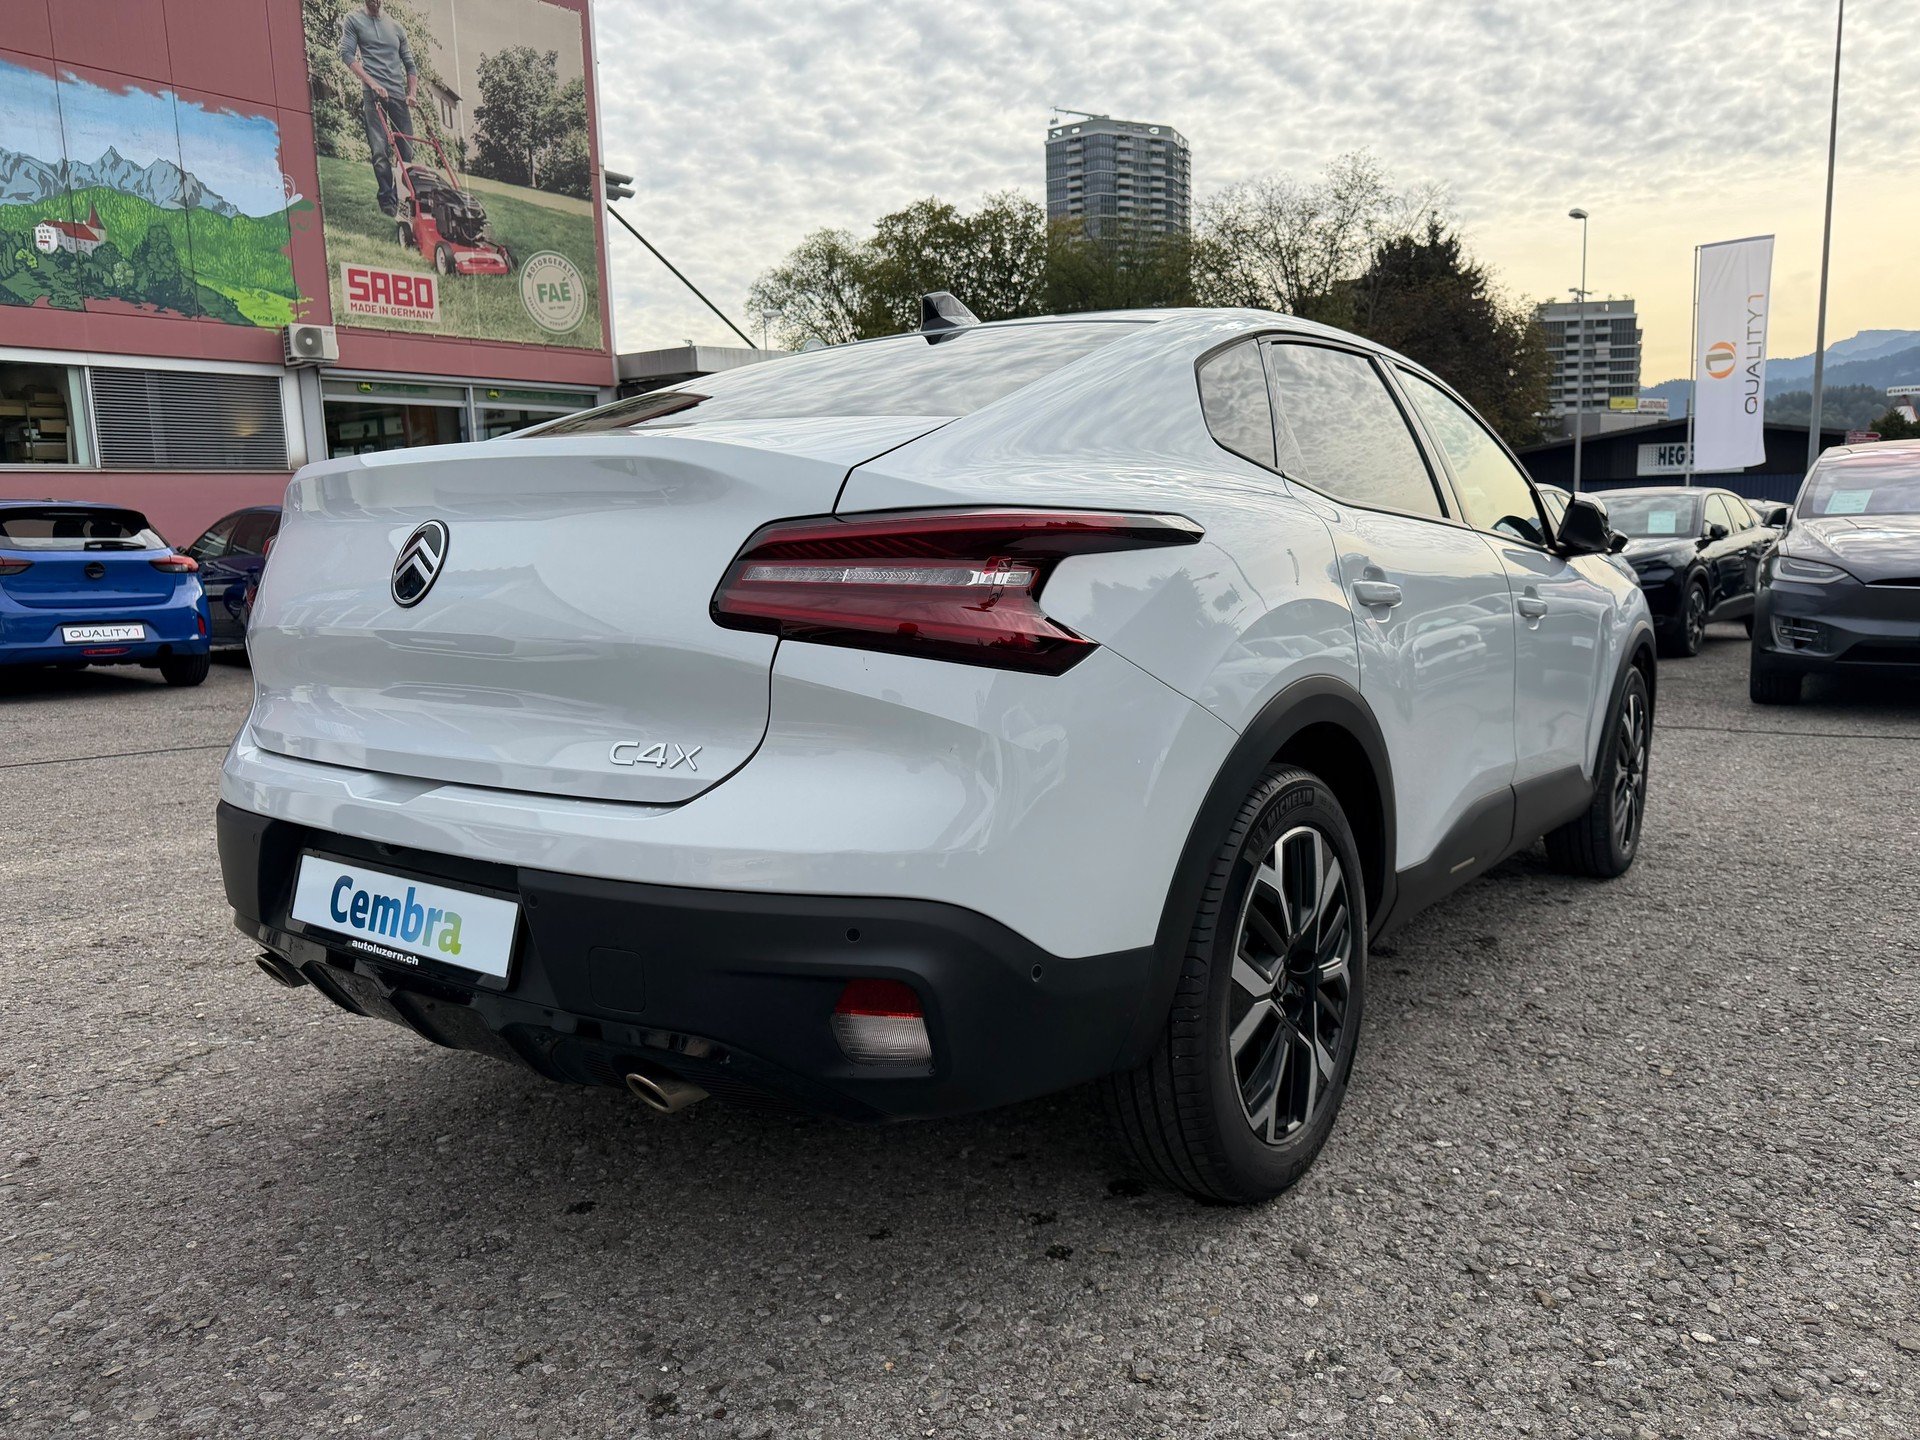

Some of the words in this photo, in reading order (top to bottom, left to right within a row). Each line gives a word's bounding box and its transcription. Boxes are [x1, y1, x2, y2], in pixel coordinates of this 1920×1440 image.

[348, 268, 434, 309] SABO
[536, 276, 572, 303] FAÉ
[350, 302, 378, 313] MADE
[379, 305, 389, 315] IN
[391, 307, 435, 319] GERMANY
[1744, 308, 1764, 415] QUALITY
[69, 628, 131, 639] QUALITY
[1266, 789, 1314, 831] MICHELIN
[330, 875, 462, 955] Cembra
[351, 938, 419, 966] autoluzern.ch
